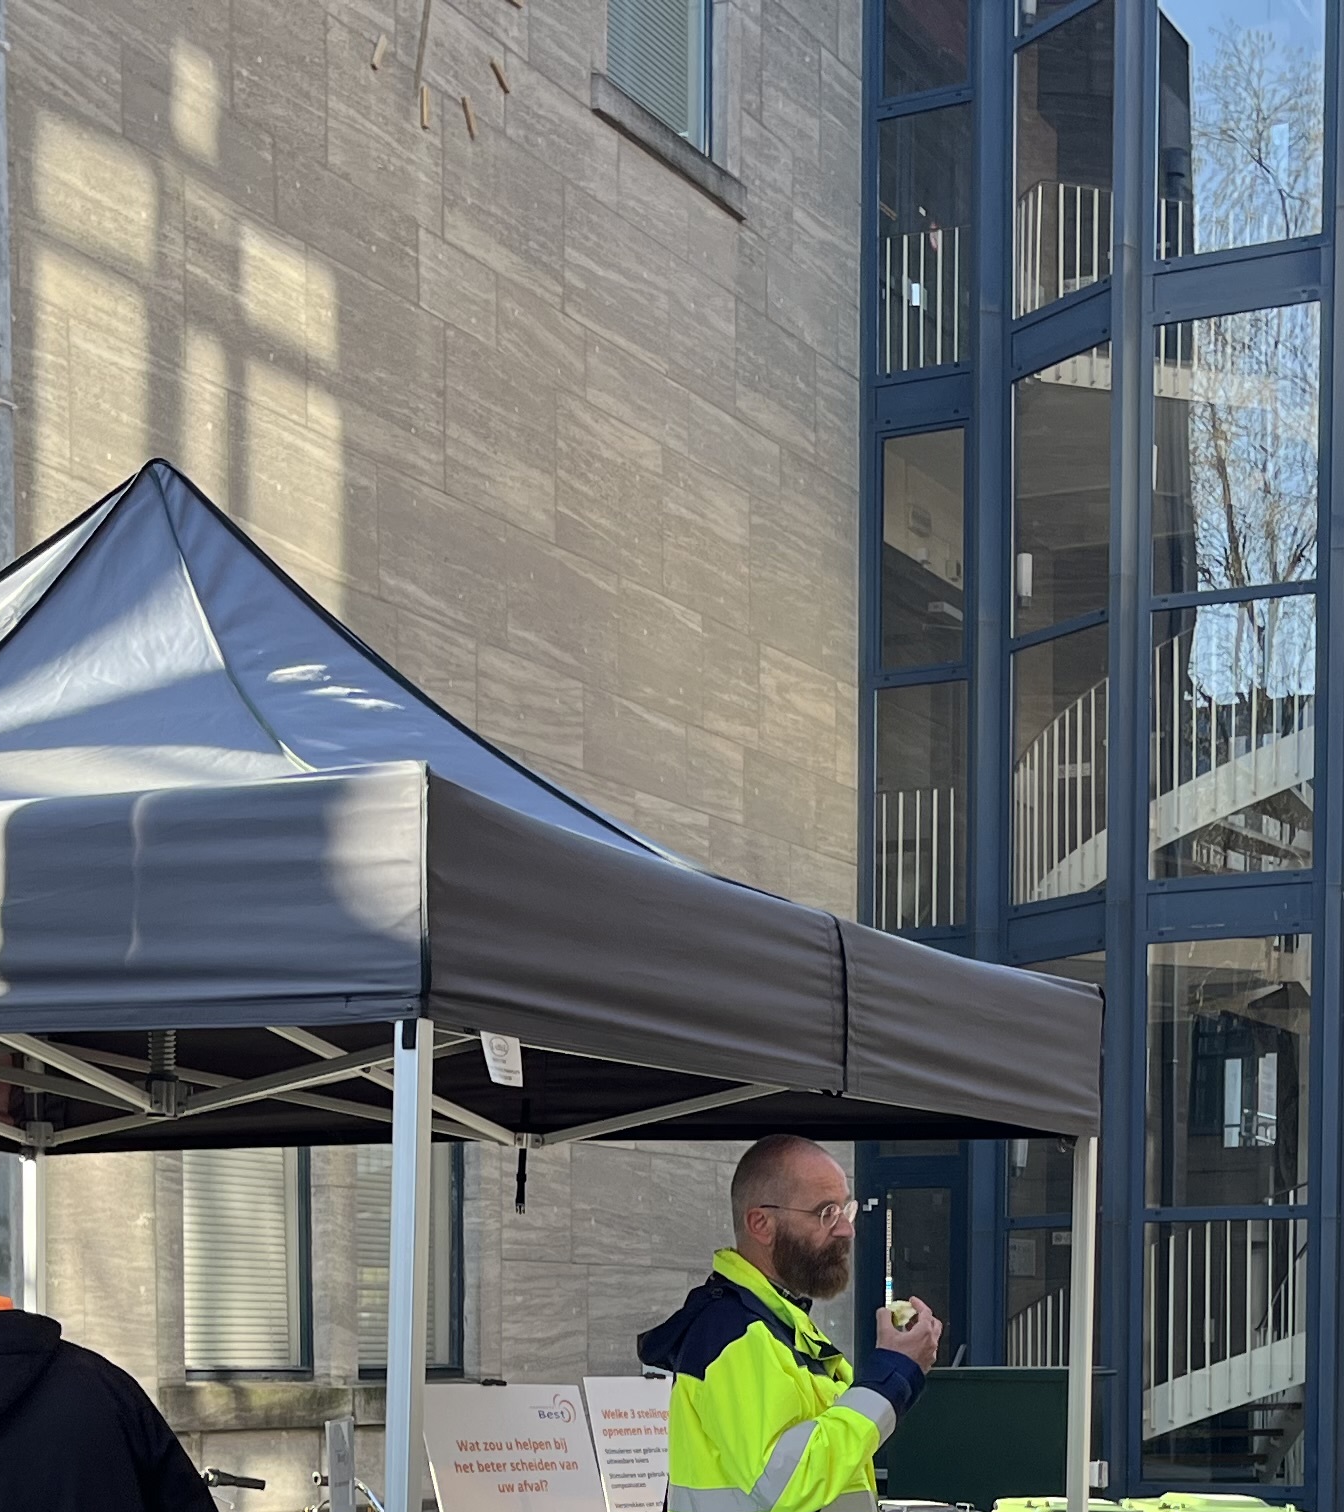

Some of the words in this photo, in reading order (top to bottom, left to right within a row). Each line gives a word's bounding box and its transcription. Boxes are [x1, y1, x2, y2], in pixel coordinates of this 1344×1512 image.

[538, 1409, 565, 1420] Best
[601, 1409, 629, 1419] Welke
[630, 1408, 636, 1419] 3
[602, 1427, 643, 1439] opnemen
[644, 1425, 653, 1436] in
[653, 1425, 668, 1436] het
[456, 1439, 481, 1452] Wat
[483, 1441, 503, 1452] zou
[506, 1441, 513, 1451] u
[515, 1437, 552, 1454] helpen
[553, 1437, 568, 1454] bij
[454, 1461, 475, 1474] het
[476, 1460, 507, 1473] beter
[510, 1458, 557, 1472] scheiden
[559, 1460, 579, 1471] van
[498, 1483, 515, 1493] uw
[518, 1480, 549, 1493] afval?
